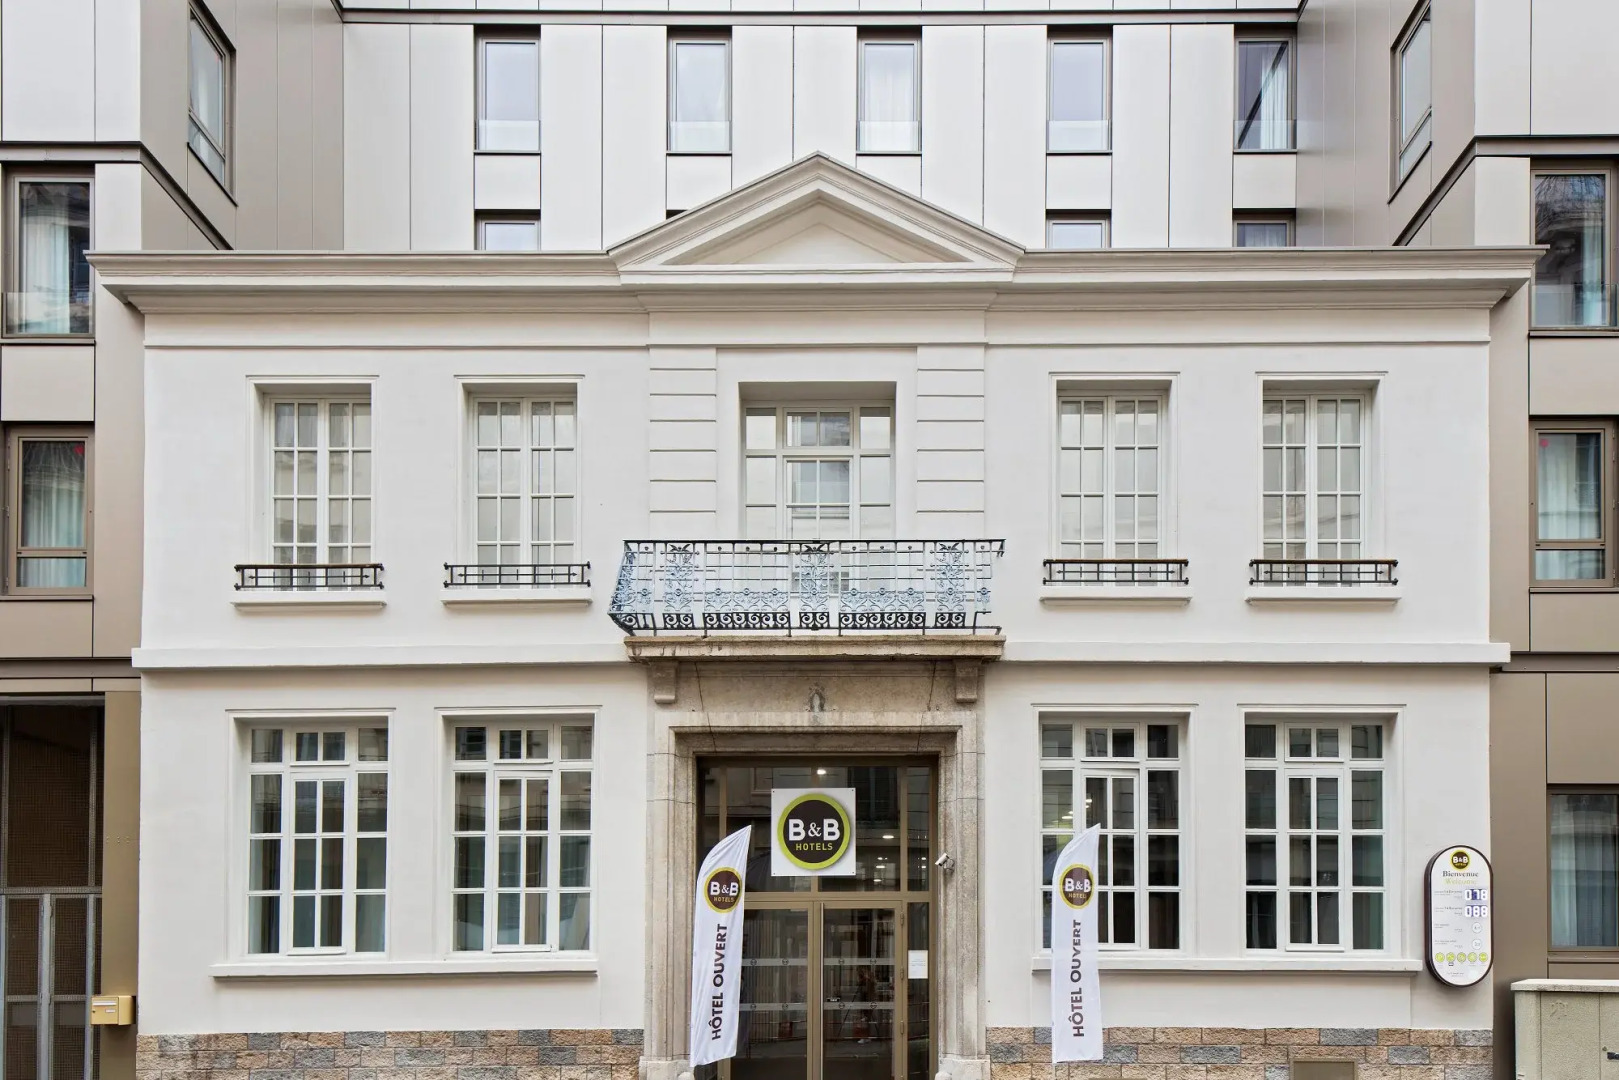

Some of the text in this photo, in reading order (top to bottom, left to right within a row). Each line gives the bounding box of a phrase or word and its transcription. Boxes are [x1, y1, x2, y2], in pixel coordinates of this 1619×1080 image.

[788, 818, 841, 841] B&B
[795, 842, 833, 851] HOTELS
[1452, 856, 1469, 864] B&B
[710, 881, 739, 896] B&B
[1064, 877, 1092, 893] B&B
[708, 923, 728, 1041] HÔTEL OUVERT
[1068, 919, 1085, 1037] HÔTEL OUVERT
